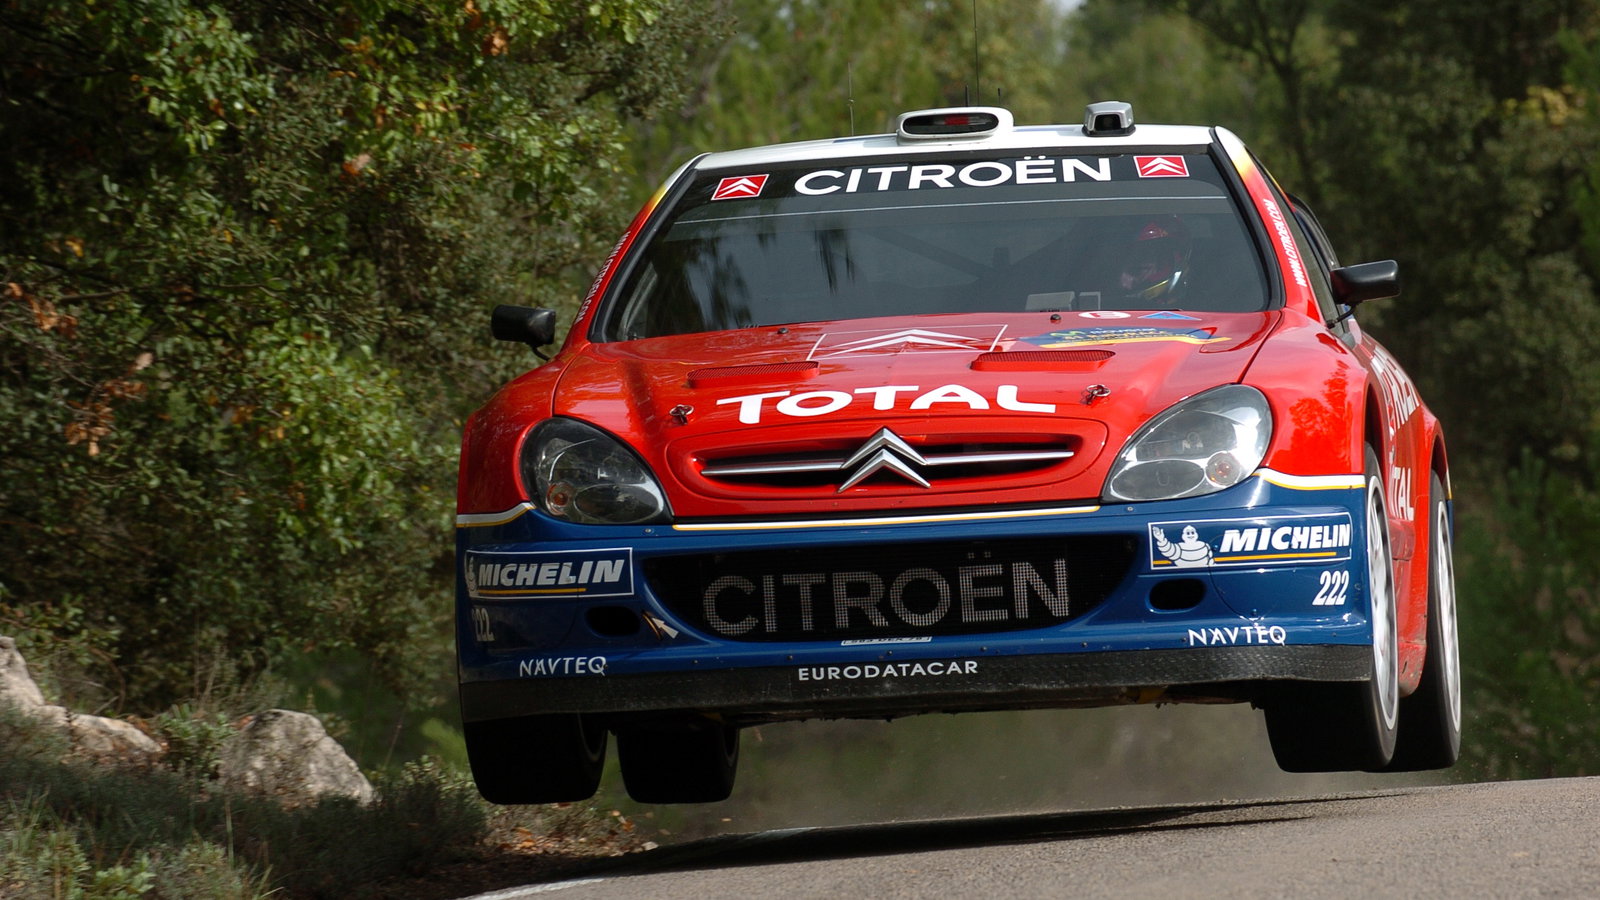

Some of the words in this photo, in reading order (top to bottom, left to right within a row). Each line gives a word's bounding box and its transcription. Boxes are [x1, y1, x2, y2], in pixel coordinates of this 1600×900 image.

[794, 155, 1112, 196] CITROËN
[716, 384, 1056, 425] TOTAL
[1219, 523, 1350, 553] MICHELIN
[478, 559, 625, 587] MICHELIN
[1312, 570, 1349, 606] 222
[703, 551, 1070, 636] CITROËN
[1188, 625, 1287, 646] NAVTEQ
[519, 656, 608, 677] NAVTEQ
[798, 660, 979, 682] EURODATACAR
